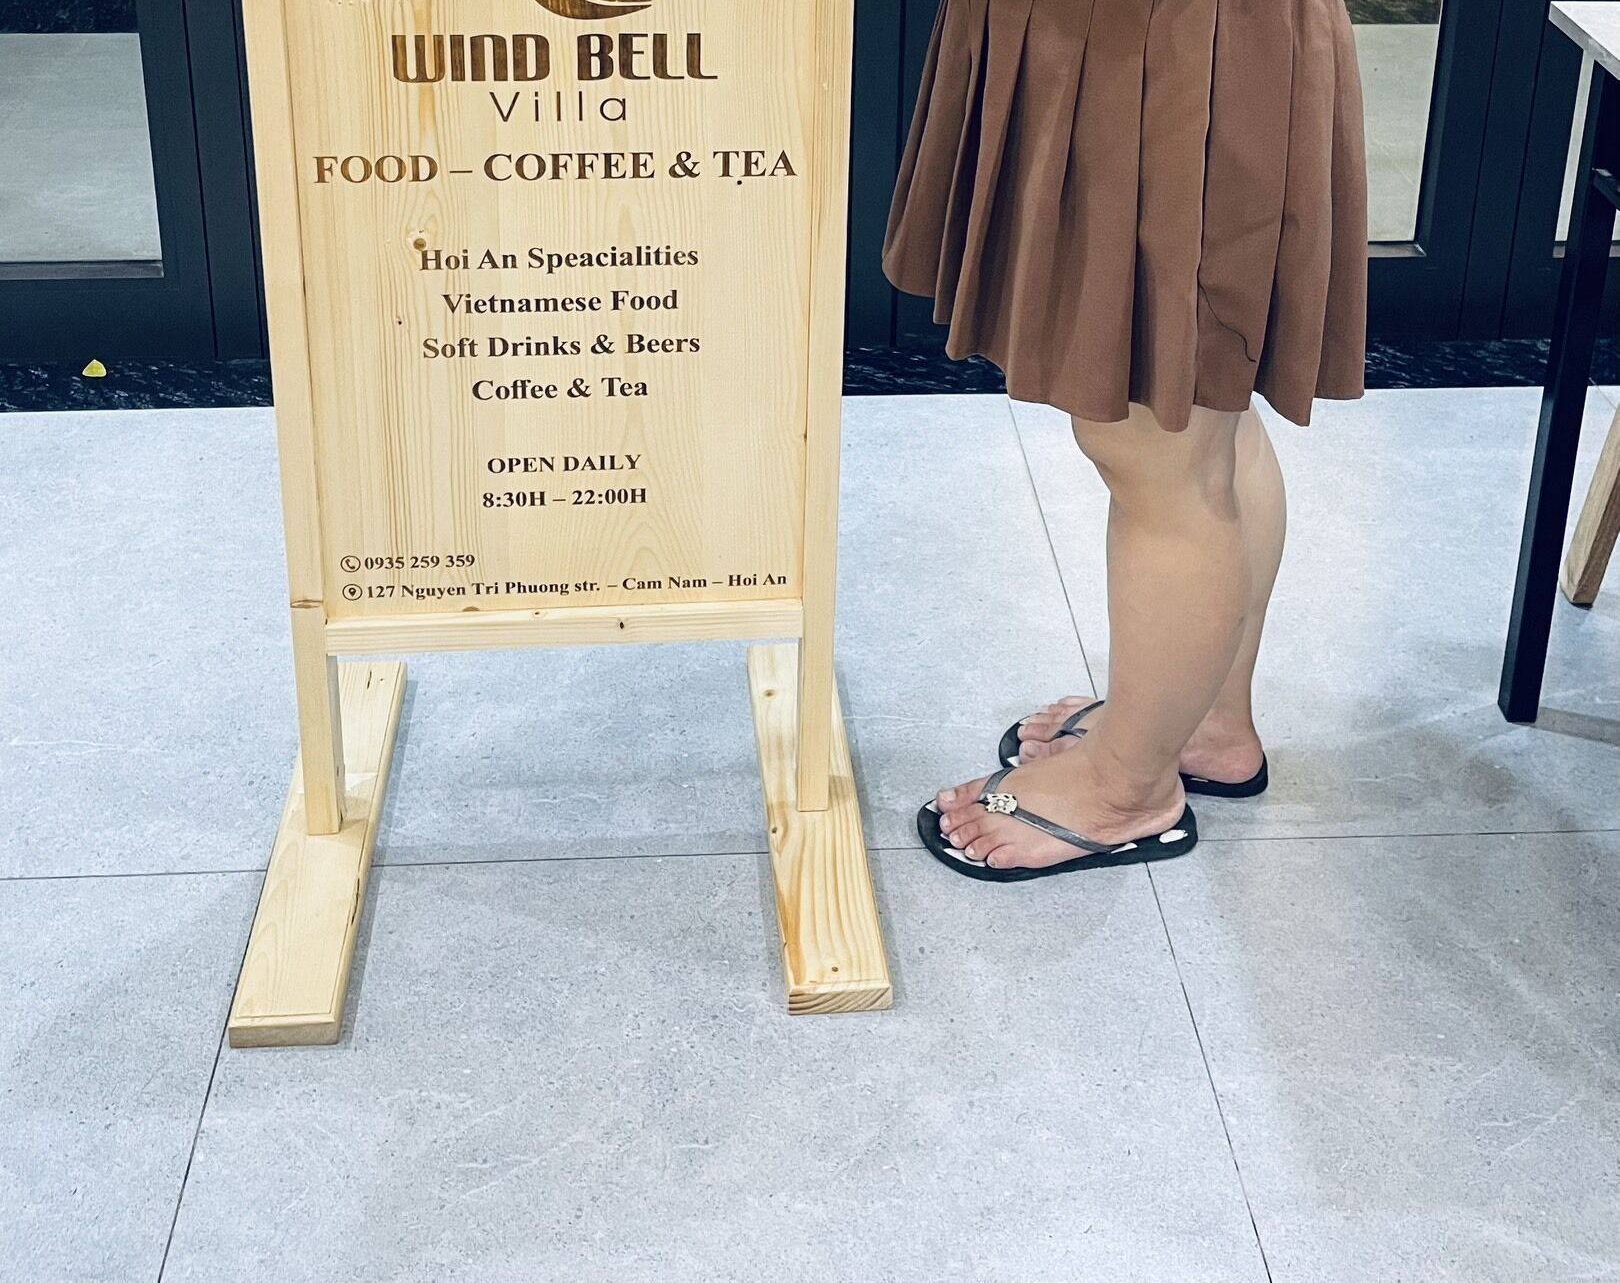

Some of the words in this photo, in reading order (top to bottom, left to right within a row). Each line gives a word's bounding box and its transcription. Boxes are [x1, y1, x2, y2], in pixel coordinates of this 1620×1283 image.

[392, 34, 550, 83] WIND
[577, 33, 718, 81] BELL
[489, 91, 626, 122] Villa
[313, 155, 438, 183] FOOD
[484, 152, 655, 181] COFFEE
[668, 151, 701, 178] &
[713, 150, 797, 177] TEA
[418, 247, 470, 271] Hoi
[476, 249, 518, 269] An
[528, 245, 698, 274] Speacialities
[441, 289, 601, 317] Vietnamese
[610, 289, 678, 311] Food
[423, 337, 478, 358] Soft
[486, 336, 581, 357] Drinks
[591, 334, 615, 355] &
[624, 334, 700, 354] Beers
[472, 379, 558, 400] Coffee
[567, 378, 592, 398] &
[601, 377, 648, 397] Tea
[488, 457, 555, 474] OPEN
[562, 454, 641, 472] DAILY
[483, 491, 547, 508] 8:30H
[572, 488, 646, 505] 22:00H
[364, 556, 405, 570] 0935
[410, 555, 440, 569] 259
[445, 554, 475, 568] 359
[368, 585, 395, 598] 127
[401, 583, 466, 600] Nguyen
[471, 582, 499, 595] Tri
[505, 582, 569, 596] Phuong
[575, 581, 600, 592] str.
[622, 578, 662, 590] Cam
[668, 576, 707, 589] Nam
[728, 574, 757, 586] Hoi
[763, 573, 786, 585] An
